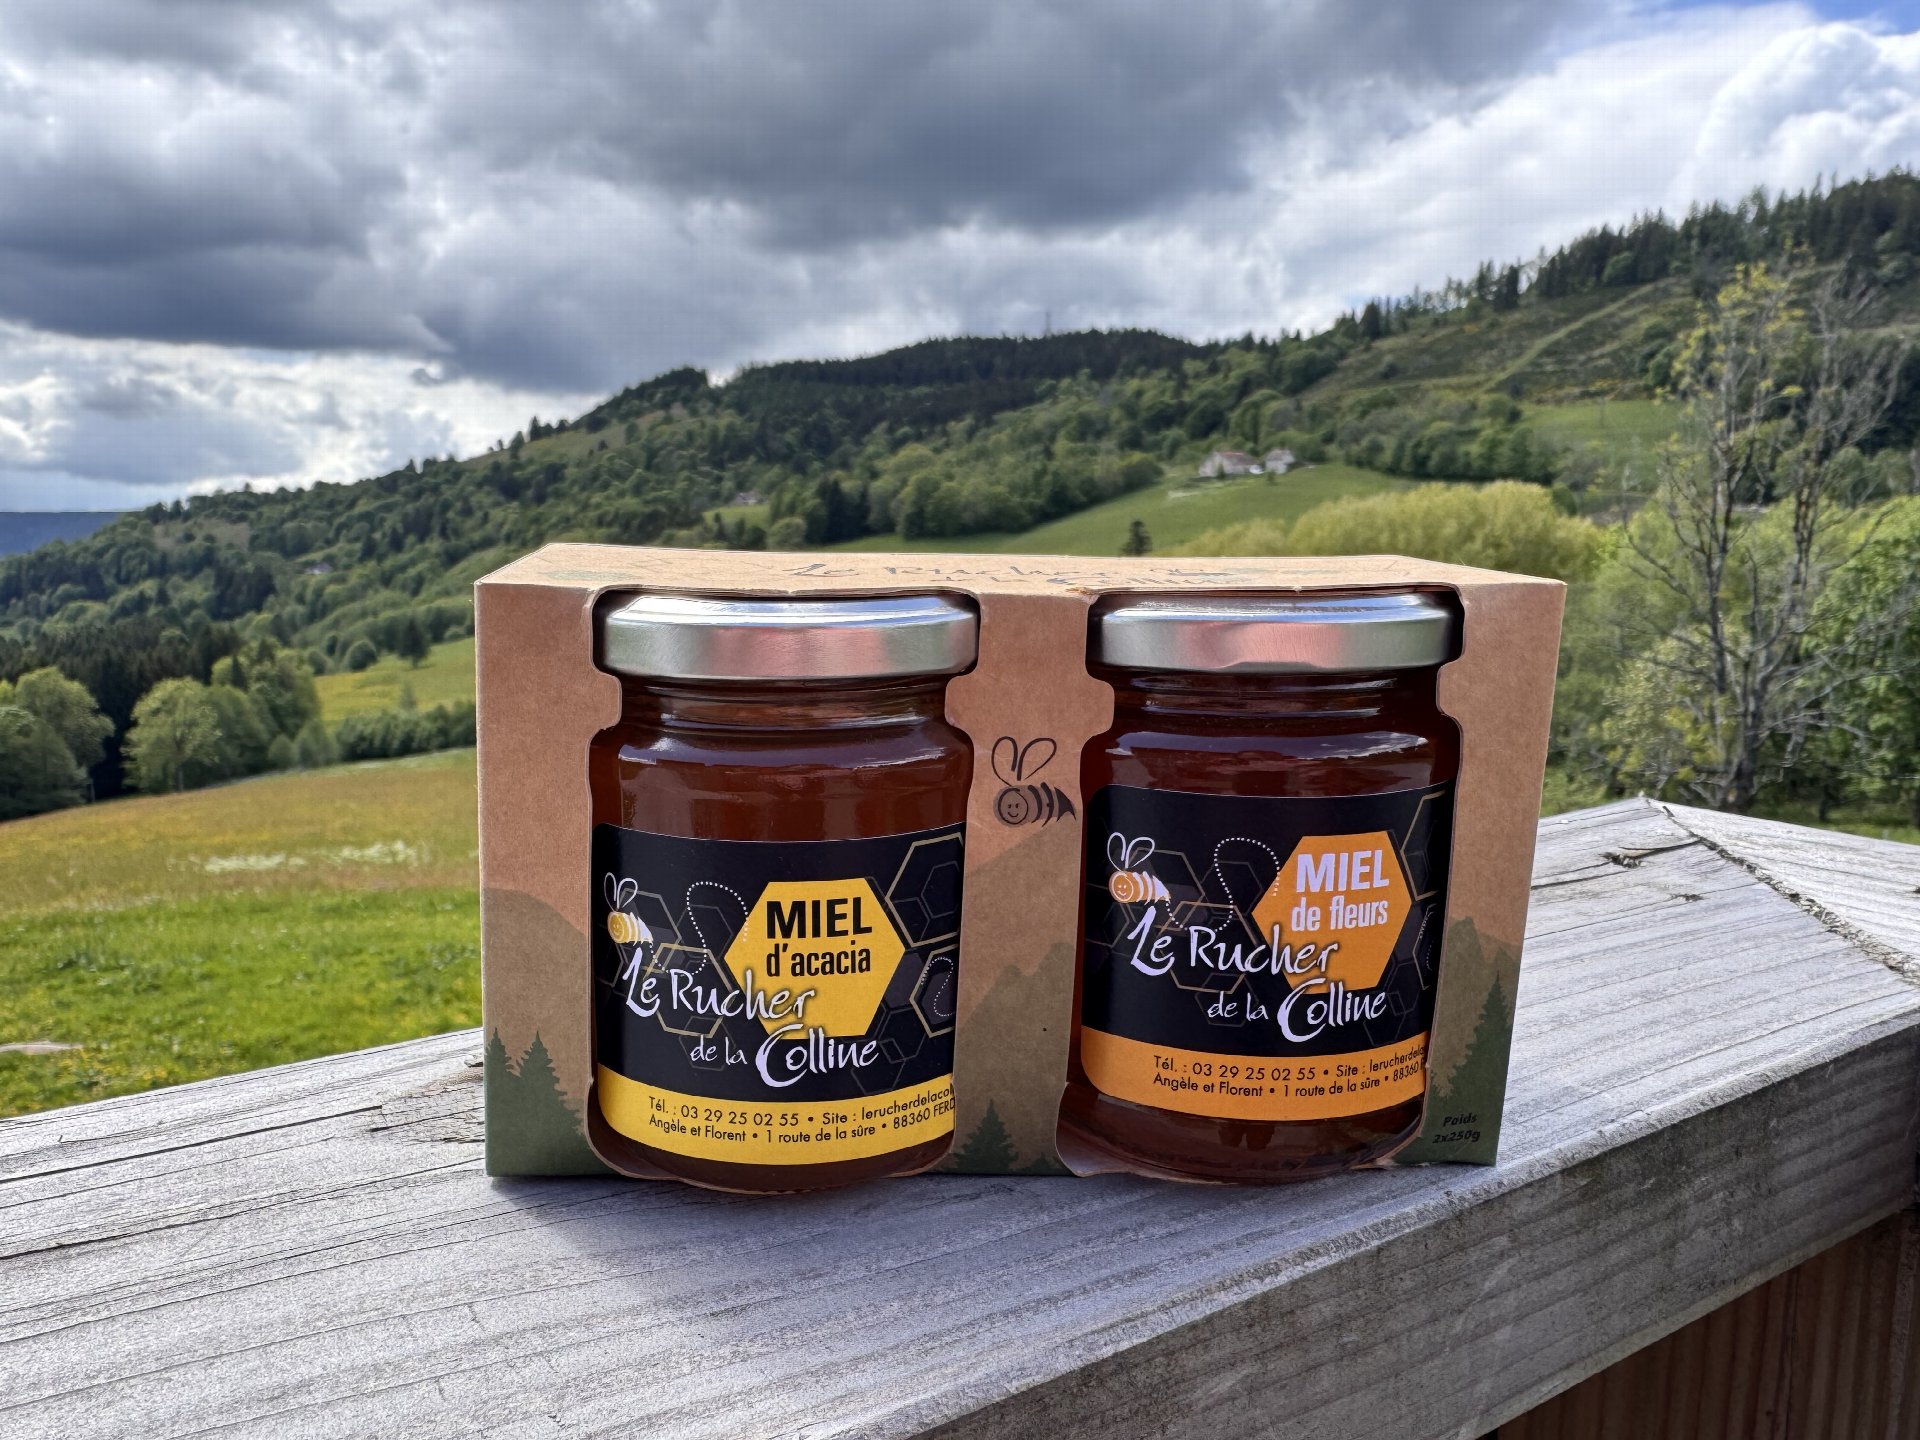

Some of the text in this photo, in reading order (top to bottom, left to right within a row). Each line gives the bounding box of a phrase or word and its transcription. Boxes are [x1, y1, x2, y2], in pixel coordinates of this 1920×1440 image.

[1295, 850, 1390, 893] MIEL
[767, 897, 872, 940] MIEL
[1291, 896, 1389, 932] de fleurs
[767, 940, 871, 977] d'acacia
[1127, 906, 1339, 977] Le Rucher
[622, 947, 815, 1021] Le Rucher
[1207, 977, 1387, 1043] de la Colline
[690, 1024, 879, 1088] de la Colline
[1192, 1062, 1212, 1076] 03
[1219, 1064, 1239, 1078] 29
[1245, 1067, 1265, 1080] 25
[1271, 1068, 1291, 1081] 02
[1296, 1067, 1316, 1080] 55
[1336, 1064, 1358, 1078] Site
[1153, 1072, 1199, 1092] Angèle
[1203, 1082, 1215, 1093] et
[1219, 1081, 1262, 1096] Florent
[1283, 1084, 1288, 1096] 1
[1295, 1084, 1325, 1096] route
[1329, 1081, 1343, 1094] de
[1347, 1079, 1356, 1092] la
[1360, 1077, 1380, 1090] sûre
[1393, 1063, 1419, 1082] 88360
[649, 1114, 687, 1134] Angèle
[690, 1126, 701, 1137] et
[705, 1125, 746, 1142] Florent
[766, 1130, 772, 1143] 1
[778, 1132, 811, 1143] route
[815, 1128, 831, 1142] de
[836, 1126, 847, 1140] la
[851, 1125, 875, 1138] sûre
[893, 1108, 930, 1129] 88360
[681, 1104, 699, 1118] 03
[704, 1108, 723, 1122] 29
[728, 1111, 747, 1125] 25
[753, 1113, 773, 1126] 02
[779, 1113, 799, 1126] 55
[822, 1112, 848, 1125] Site
[1443, 1112, 1477, 1127] Poids
[1432, 1130, 1481, 1144] 2x250g
